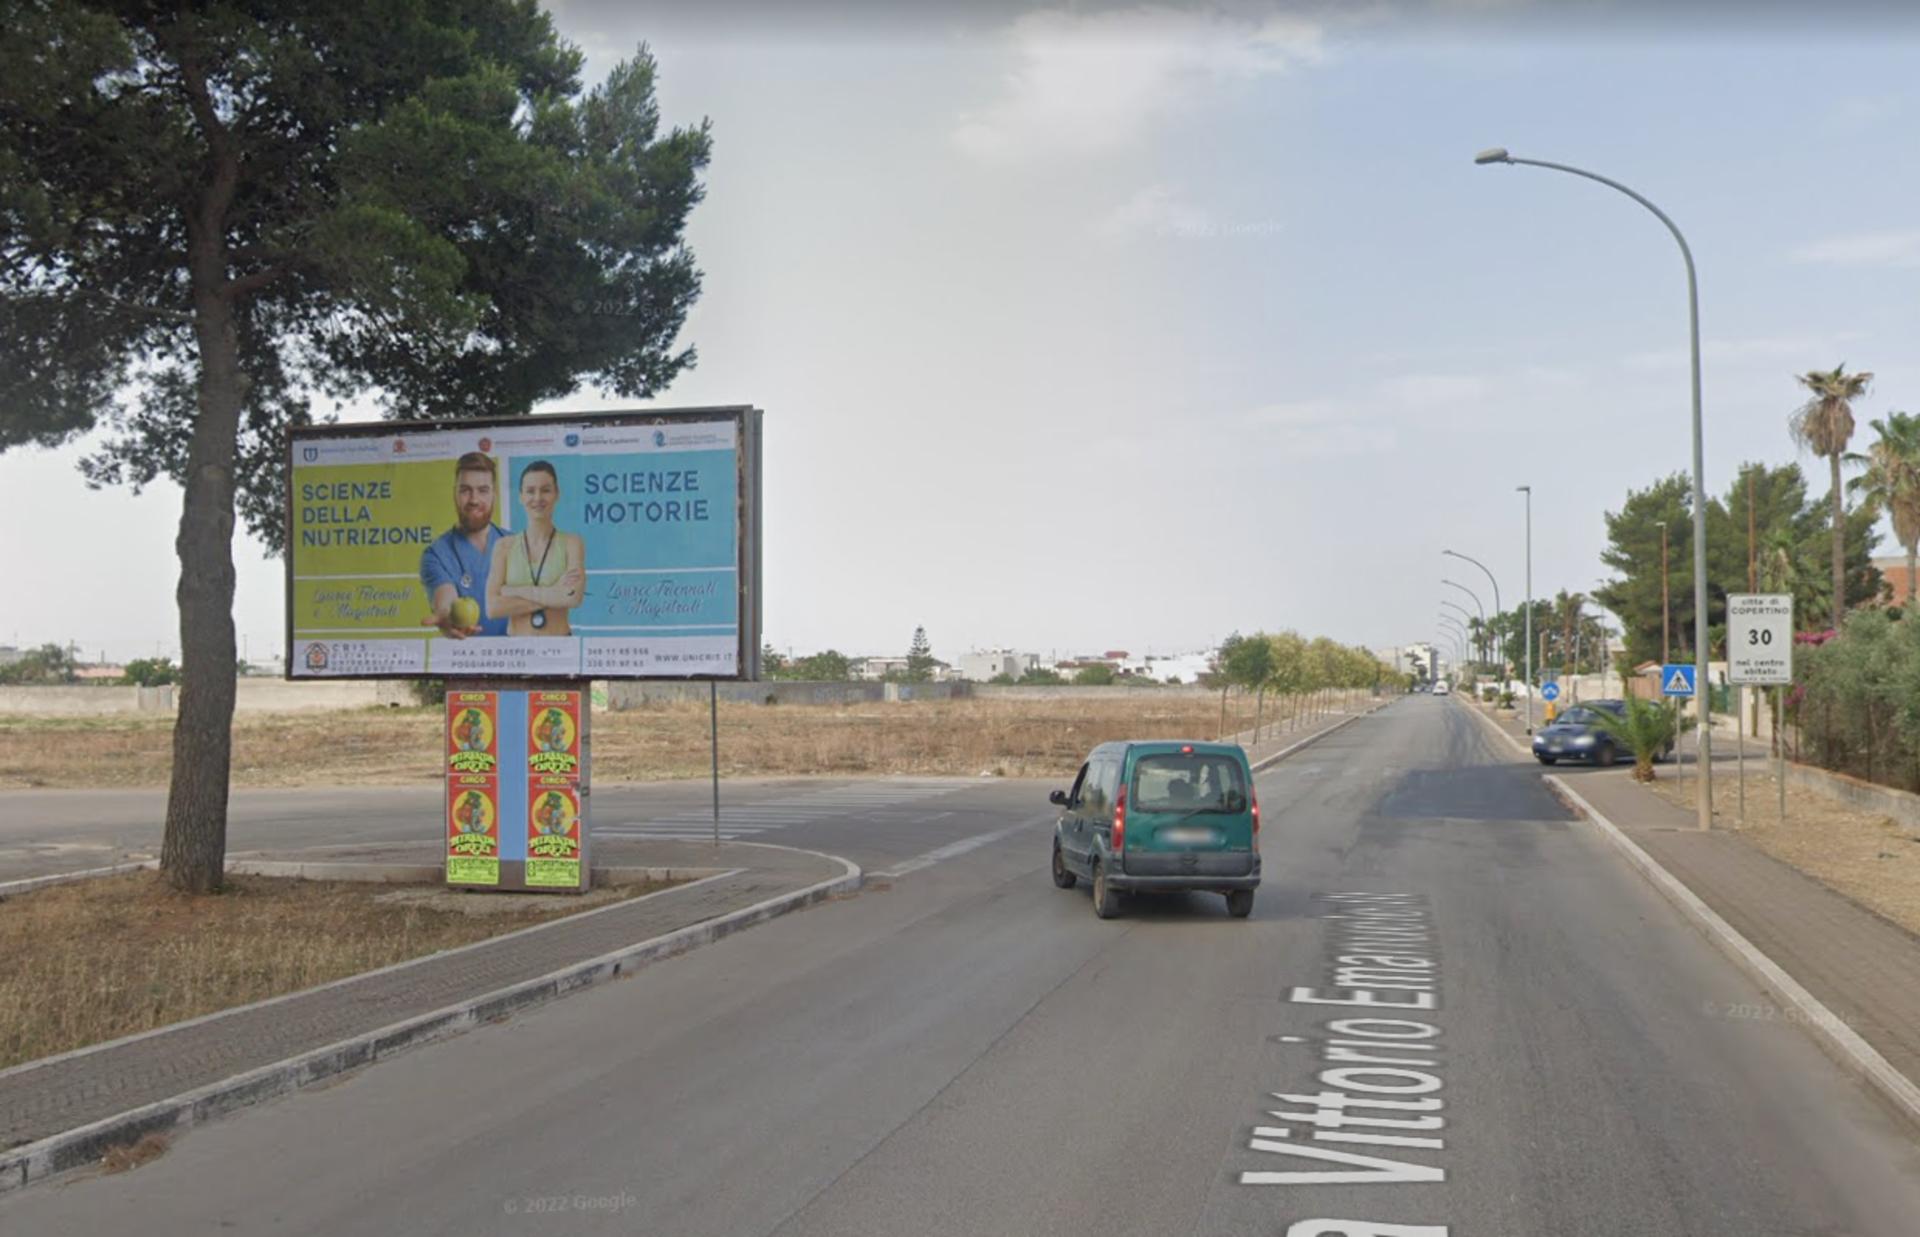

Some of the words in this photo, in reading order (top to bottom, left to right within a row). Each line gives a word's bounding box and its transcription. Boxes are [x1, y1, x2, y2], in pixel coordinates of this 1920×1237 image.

[584, 470, 700, 495] SCIENZE
[302, 481, 392, 501] SCIENZE
[302, 505, 372, 524] DELLA
[584, 499, 710, 524] MOTORIE
[302, 526, 433, 547] NUTRIZIONE
[1731, 607, 1789, 615] COPERTINO
[1748, 628, 1773, 646] 30
[1754, 659, 1785, 667] centro
[459, 693, 486, 702] CIRCO
[540, 693, 568, 702] CIRCO
[459, 775, 487, 784] CIRCO
[540, 776, 568, 785] CIRCO
